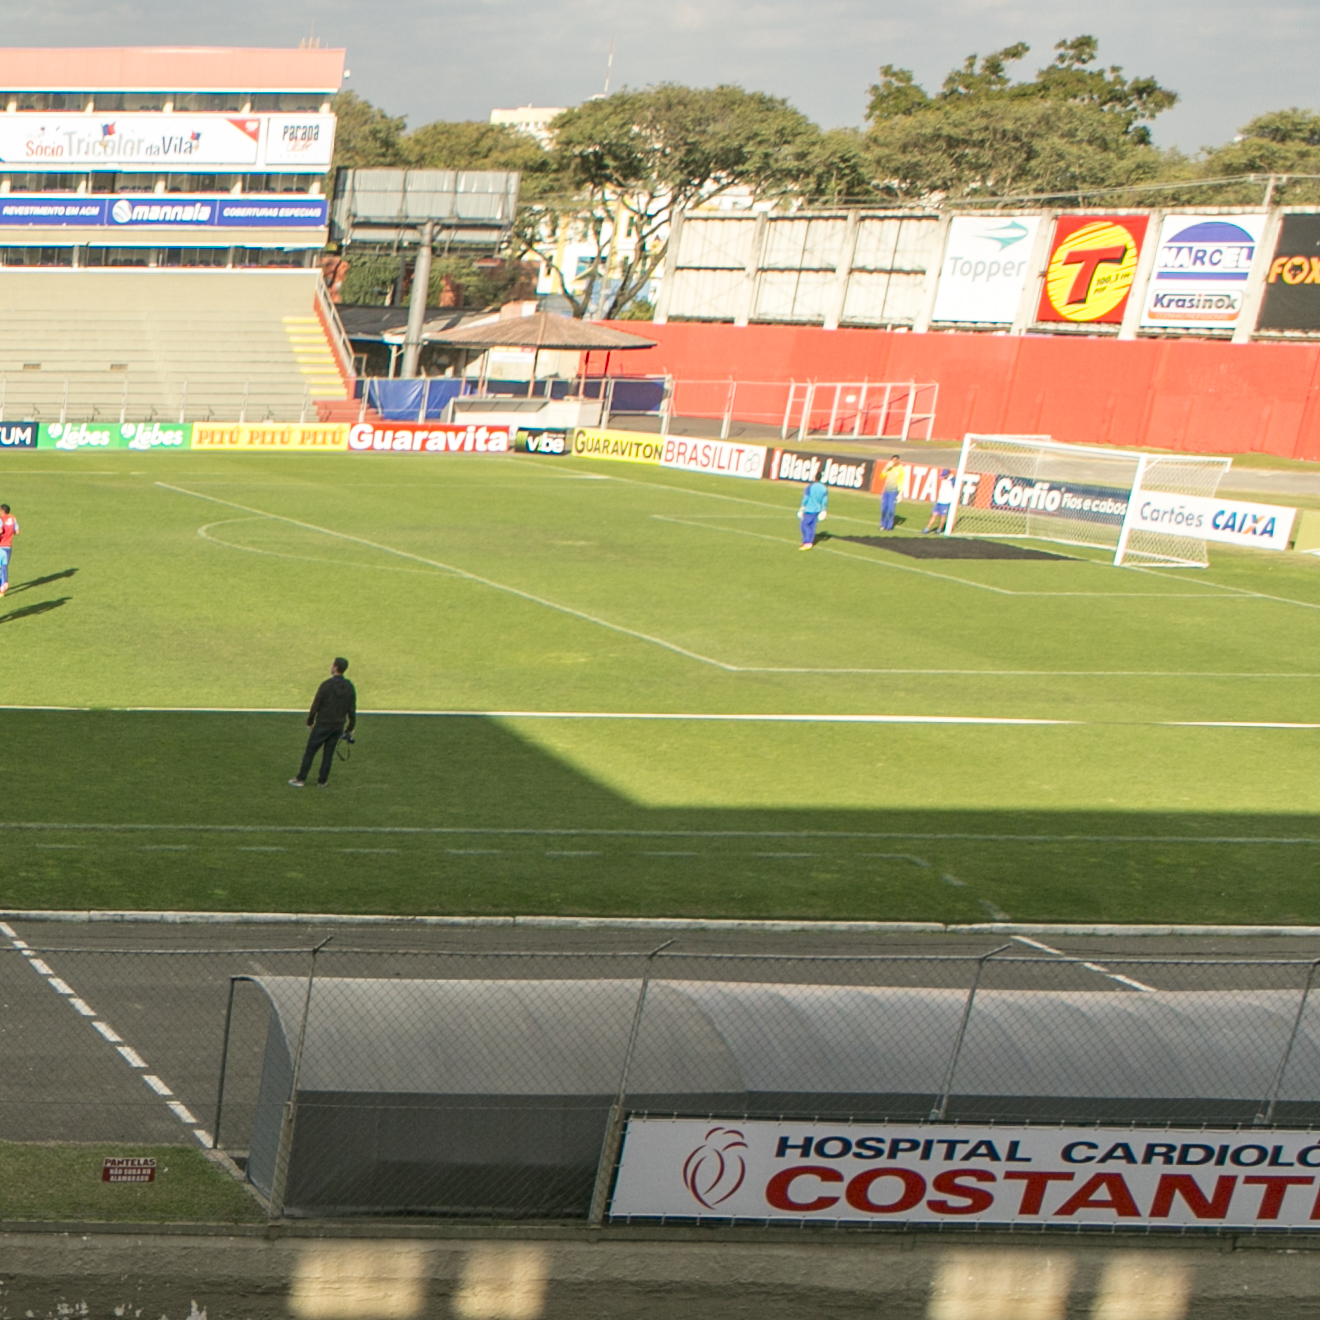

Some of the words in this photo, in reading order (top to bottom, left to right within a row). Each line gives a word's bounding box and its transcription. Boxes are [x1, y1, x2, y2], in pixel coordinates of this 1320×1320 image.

[64, 131, 145, 156] Tricolor
[146, 142, 160, 156] da
[162, 136, 193, 155] Vila
[67, 207, 79, 216] EM
[223, 208, 278, 217] COBERTURAS
[280, 208, 322, 217] ESPECIAIS
[950, 257, 1026, 283] Topper
[1159, 246, 1254, 268] MARCEL
[1153, 293, 1238, 310] Krasinox
[198, 427, 241, 445] PITÚ
[249, 427, 292, 445] PITÚ
[300, 427, 344, 445] PITÚ
[349, 424, 508, 451] Guaravita
[575, 430, 663, 460] GUARAVITON
[665, 441, 745, 472] BRASILIT
[780, 453, 820, 481] Black
[821, 458, 864, 488] Jeans
[993, 477, 1061, 512] Corfio
[1062, 492, 1083, 509] Fios
[1091, 498, 1127, 515] cabos
[1140, 502, 1203, 527] Cartões
[1212, 510, 1276, 538] CAIXA
[104, 1158, 155, 1166] PANTELAS
[775, 1136, 1032, 1163] HOSPITAL
